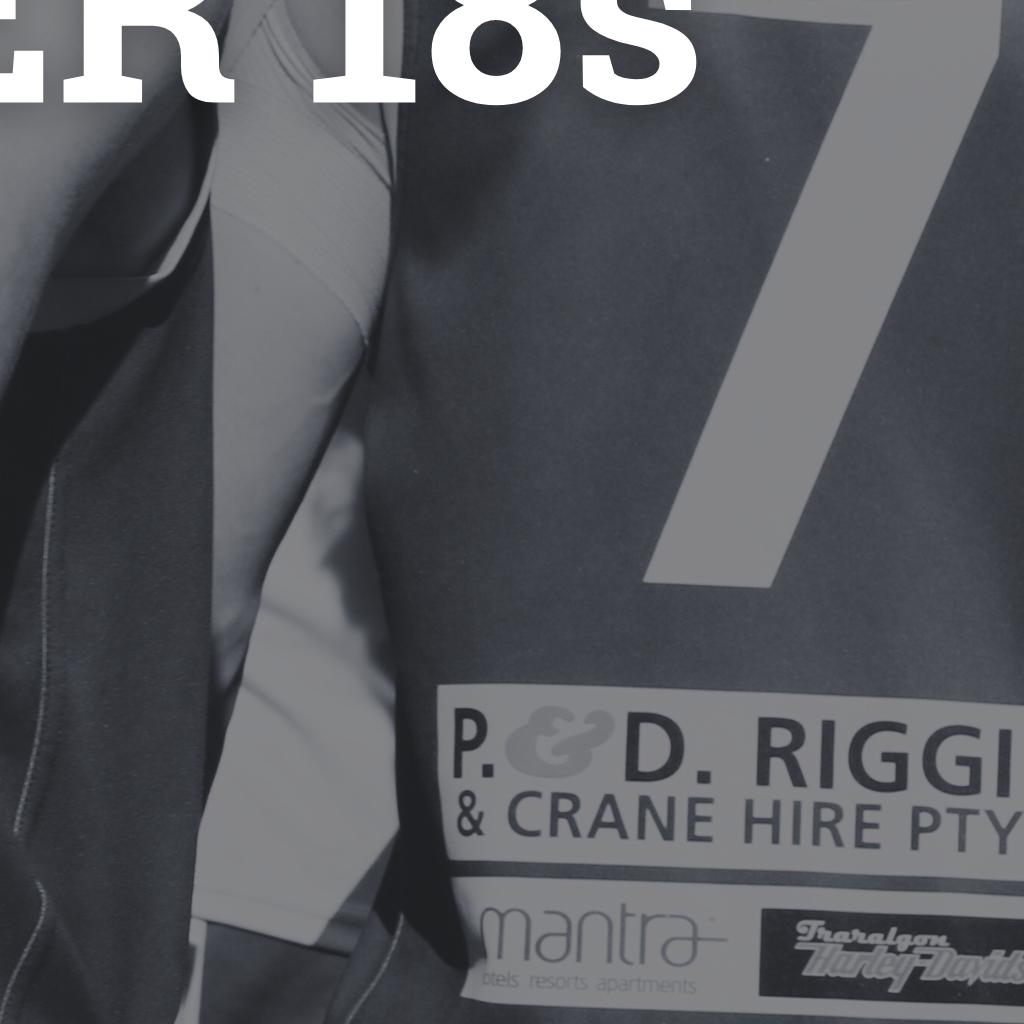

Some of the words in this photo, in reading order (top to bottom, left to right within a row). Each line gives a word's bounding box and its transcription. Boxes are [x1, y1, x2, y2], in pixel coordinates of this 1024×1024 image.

[452, 707, 495, 779] P.
[504, 705, 616, 779] &
[624, 711, 713, 785] D.
[754, 716, 1013, 799] RIGGI
[456, 790, 485, 838] &
[507, 790, 715, 844] CRANE
[743, 798, 883, 850] HIRE
[909, 805, 1024, 856] PTY
[479, 903, 729, 968] mantra
[795, 919, 950, 951] Traralgon
[482, 970, 520, 989] otels
[529, 972, 588, 991] resorts
[596, 975, 697, 995] apartments
